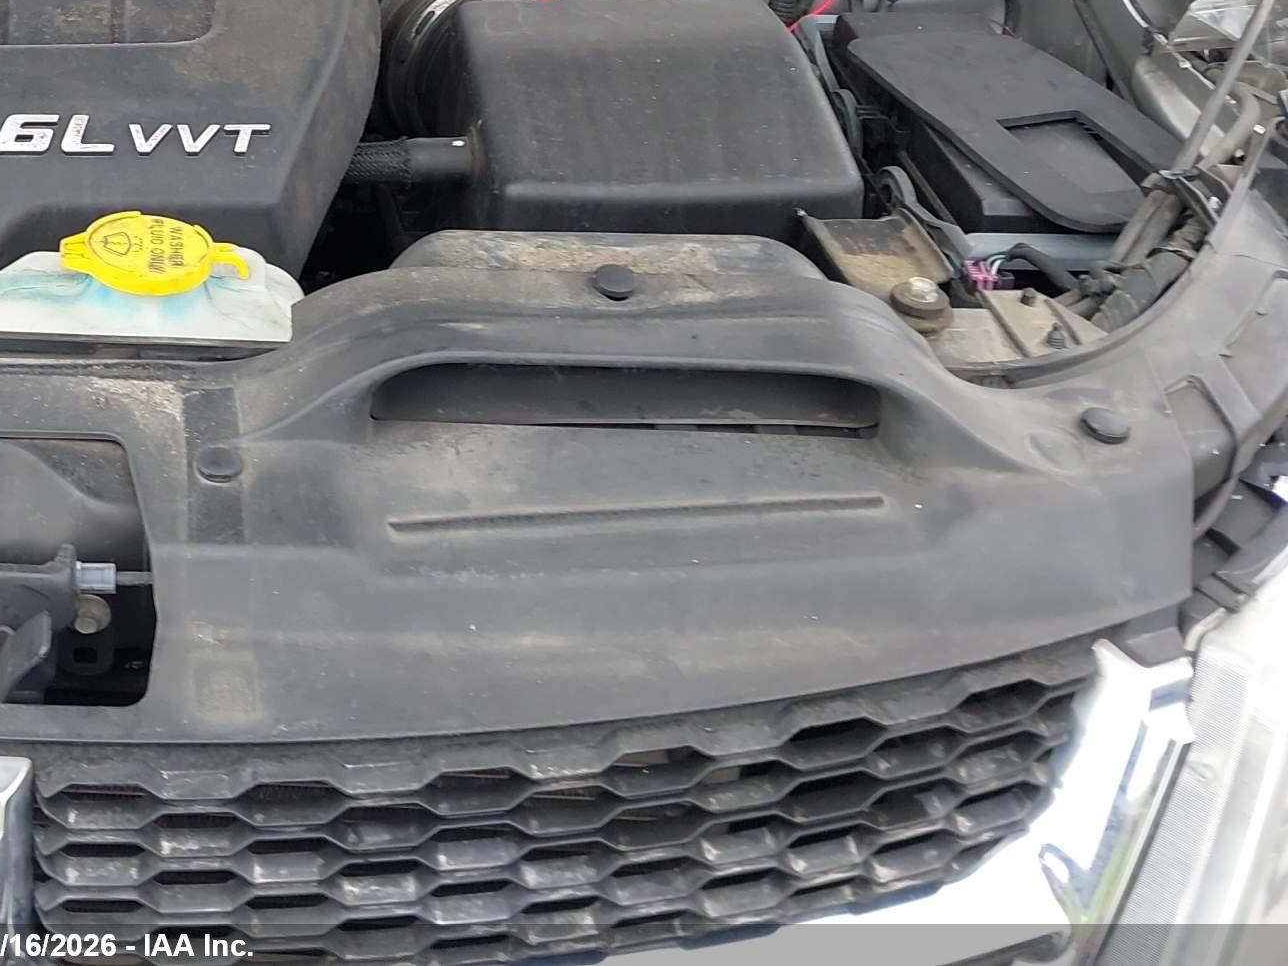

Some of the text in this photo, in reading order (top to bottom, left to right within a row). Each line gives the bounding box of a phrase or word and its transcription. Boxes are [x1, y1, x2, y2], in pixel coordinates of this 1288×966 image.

[128, 123, 272, 155] VVT
[148, 218, 165, 246] FLUID
[168, 225, 185, 267] WASHER
